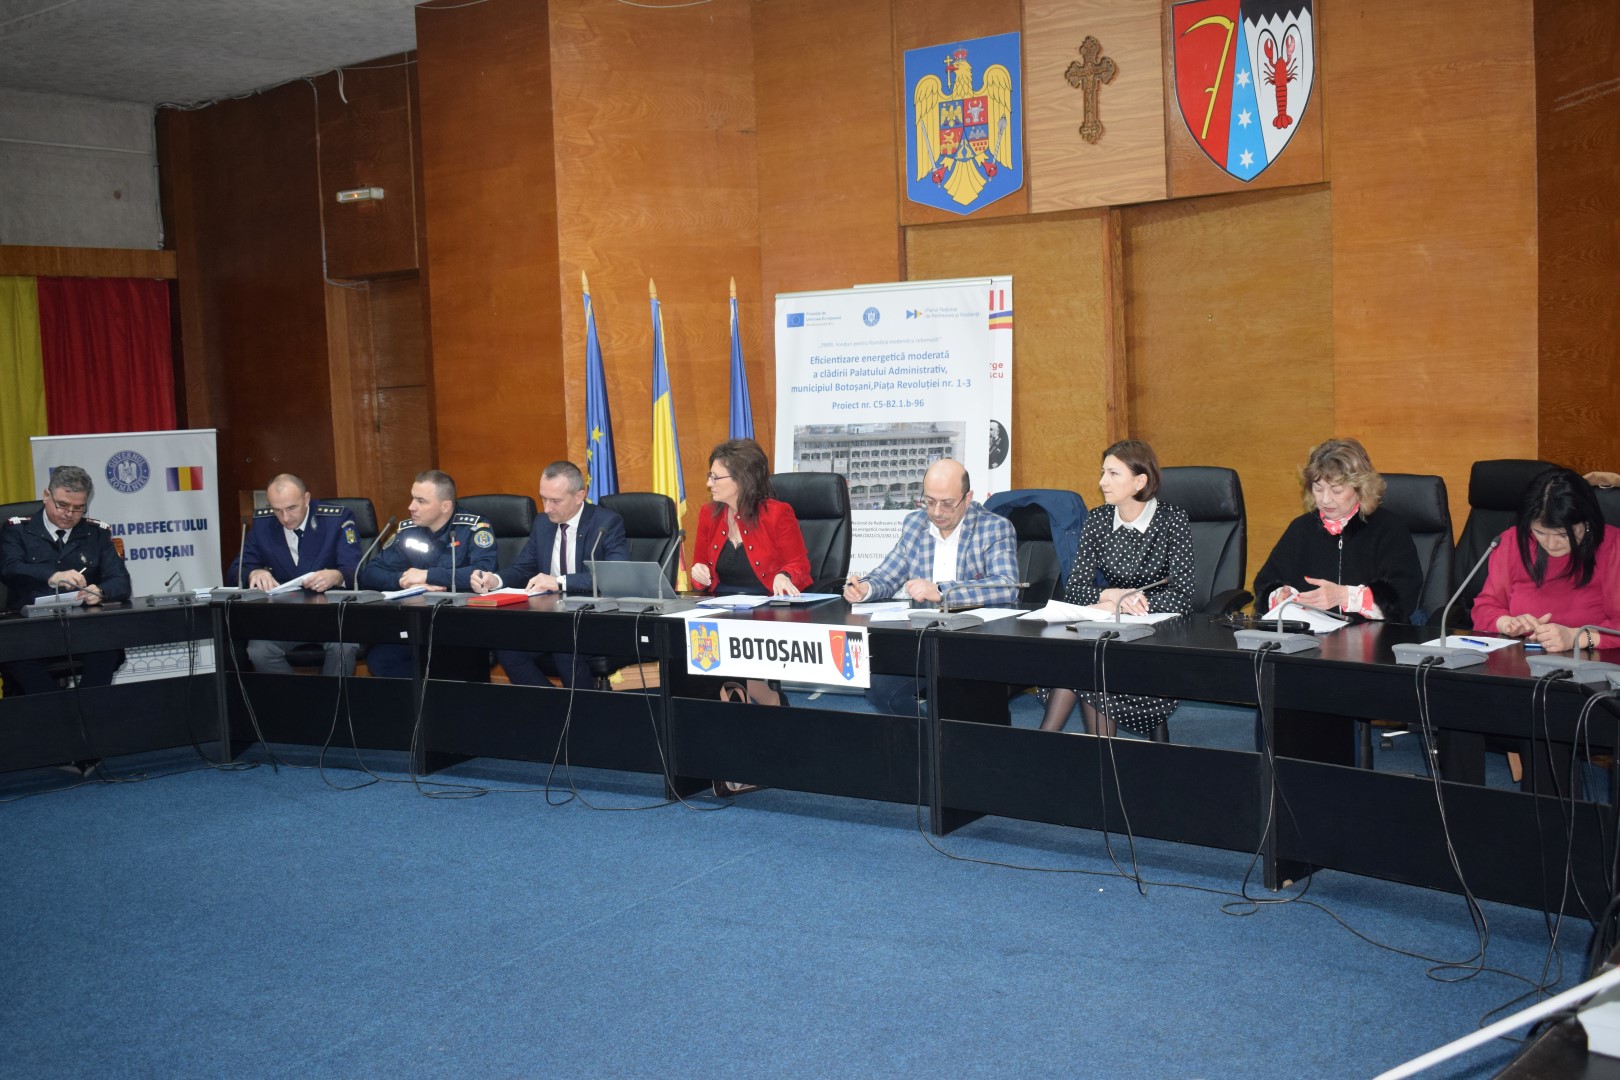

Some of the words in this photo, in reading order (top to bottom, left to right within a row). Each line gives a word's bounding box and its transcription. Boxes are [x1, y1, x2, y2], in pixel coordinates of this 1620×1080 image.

[810, 355, 860, 365] Eficientizare
[862, 352, 905, 364] energetică
[908, 350, 950, 360] moderată
[820, 369, 848, 378] clădirii
[850, 366, 886, 376] Palatului
[889, 365, 948, 375] Administrativ,
[791, 383, 833, 394] municipiul
[897, 379, 940, 390] Revoluției
[957, 379, 971, 388] 1-3
[832, 402, 859, 410] Proiect
[874, 399, 925, 408] C5-B2.1.b-96
[108, 452, 146, 468] GUVERNUL
[112, 523, 126, 536] IA
[128, 518, 208, 535] PREFECTULUI
[130, 544, 194, 561] BOTOȘANI
[729, 636, 823, 668] BOTOȘANI
